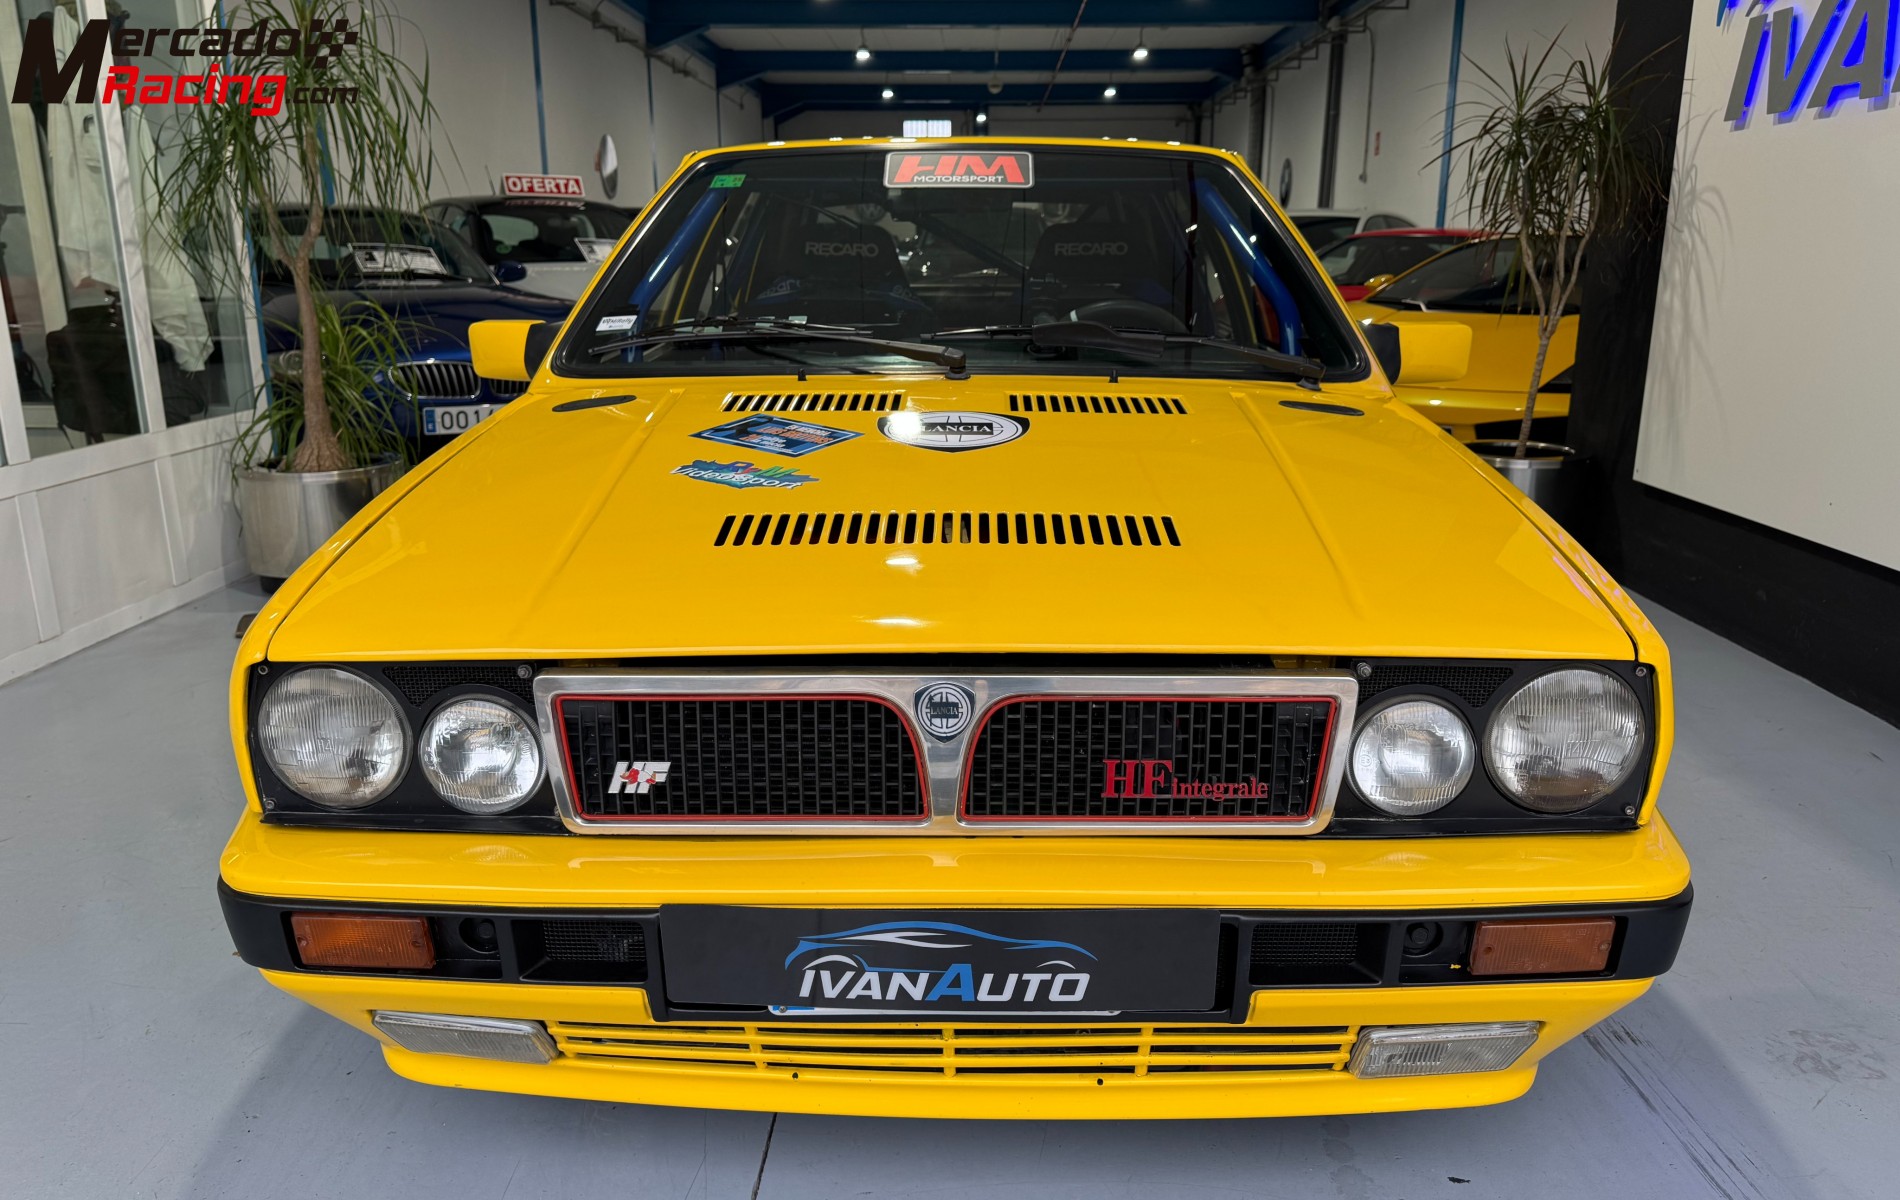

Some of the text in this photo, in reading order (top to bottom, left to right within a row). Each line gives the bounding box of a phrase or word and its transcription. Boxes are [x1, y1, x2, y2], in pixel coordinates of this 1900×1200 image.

[1724, 0, 1900, 122] IVA
[894, 156, 1025, 183] HM
[507, 177, 582, 194] OFERTA
[914, 175, 1004, 183] MOTORSPORT
[805, 242, 879, 257] RECARO
[1054, 241, 1128, 256] RECARO
[922, 424, 992, 433] LANCIA
[930, 706, 959, 715] LANCIA
[607, 761, 671, 794] HF
[1101, 759, 1268, 801] HF integrale
